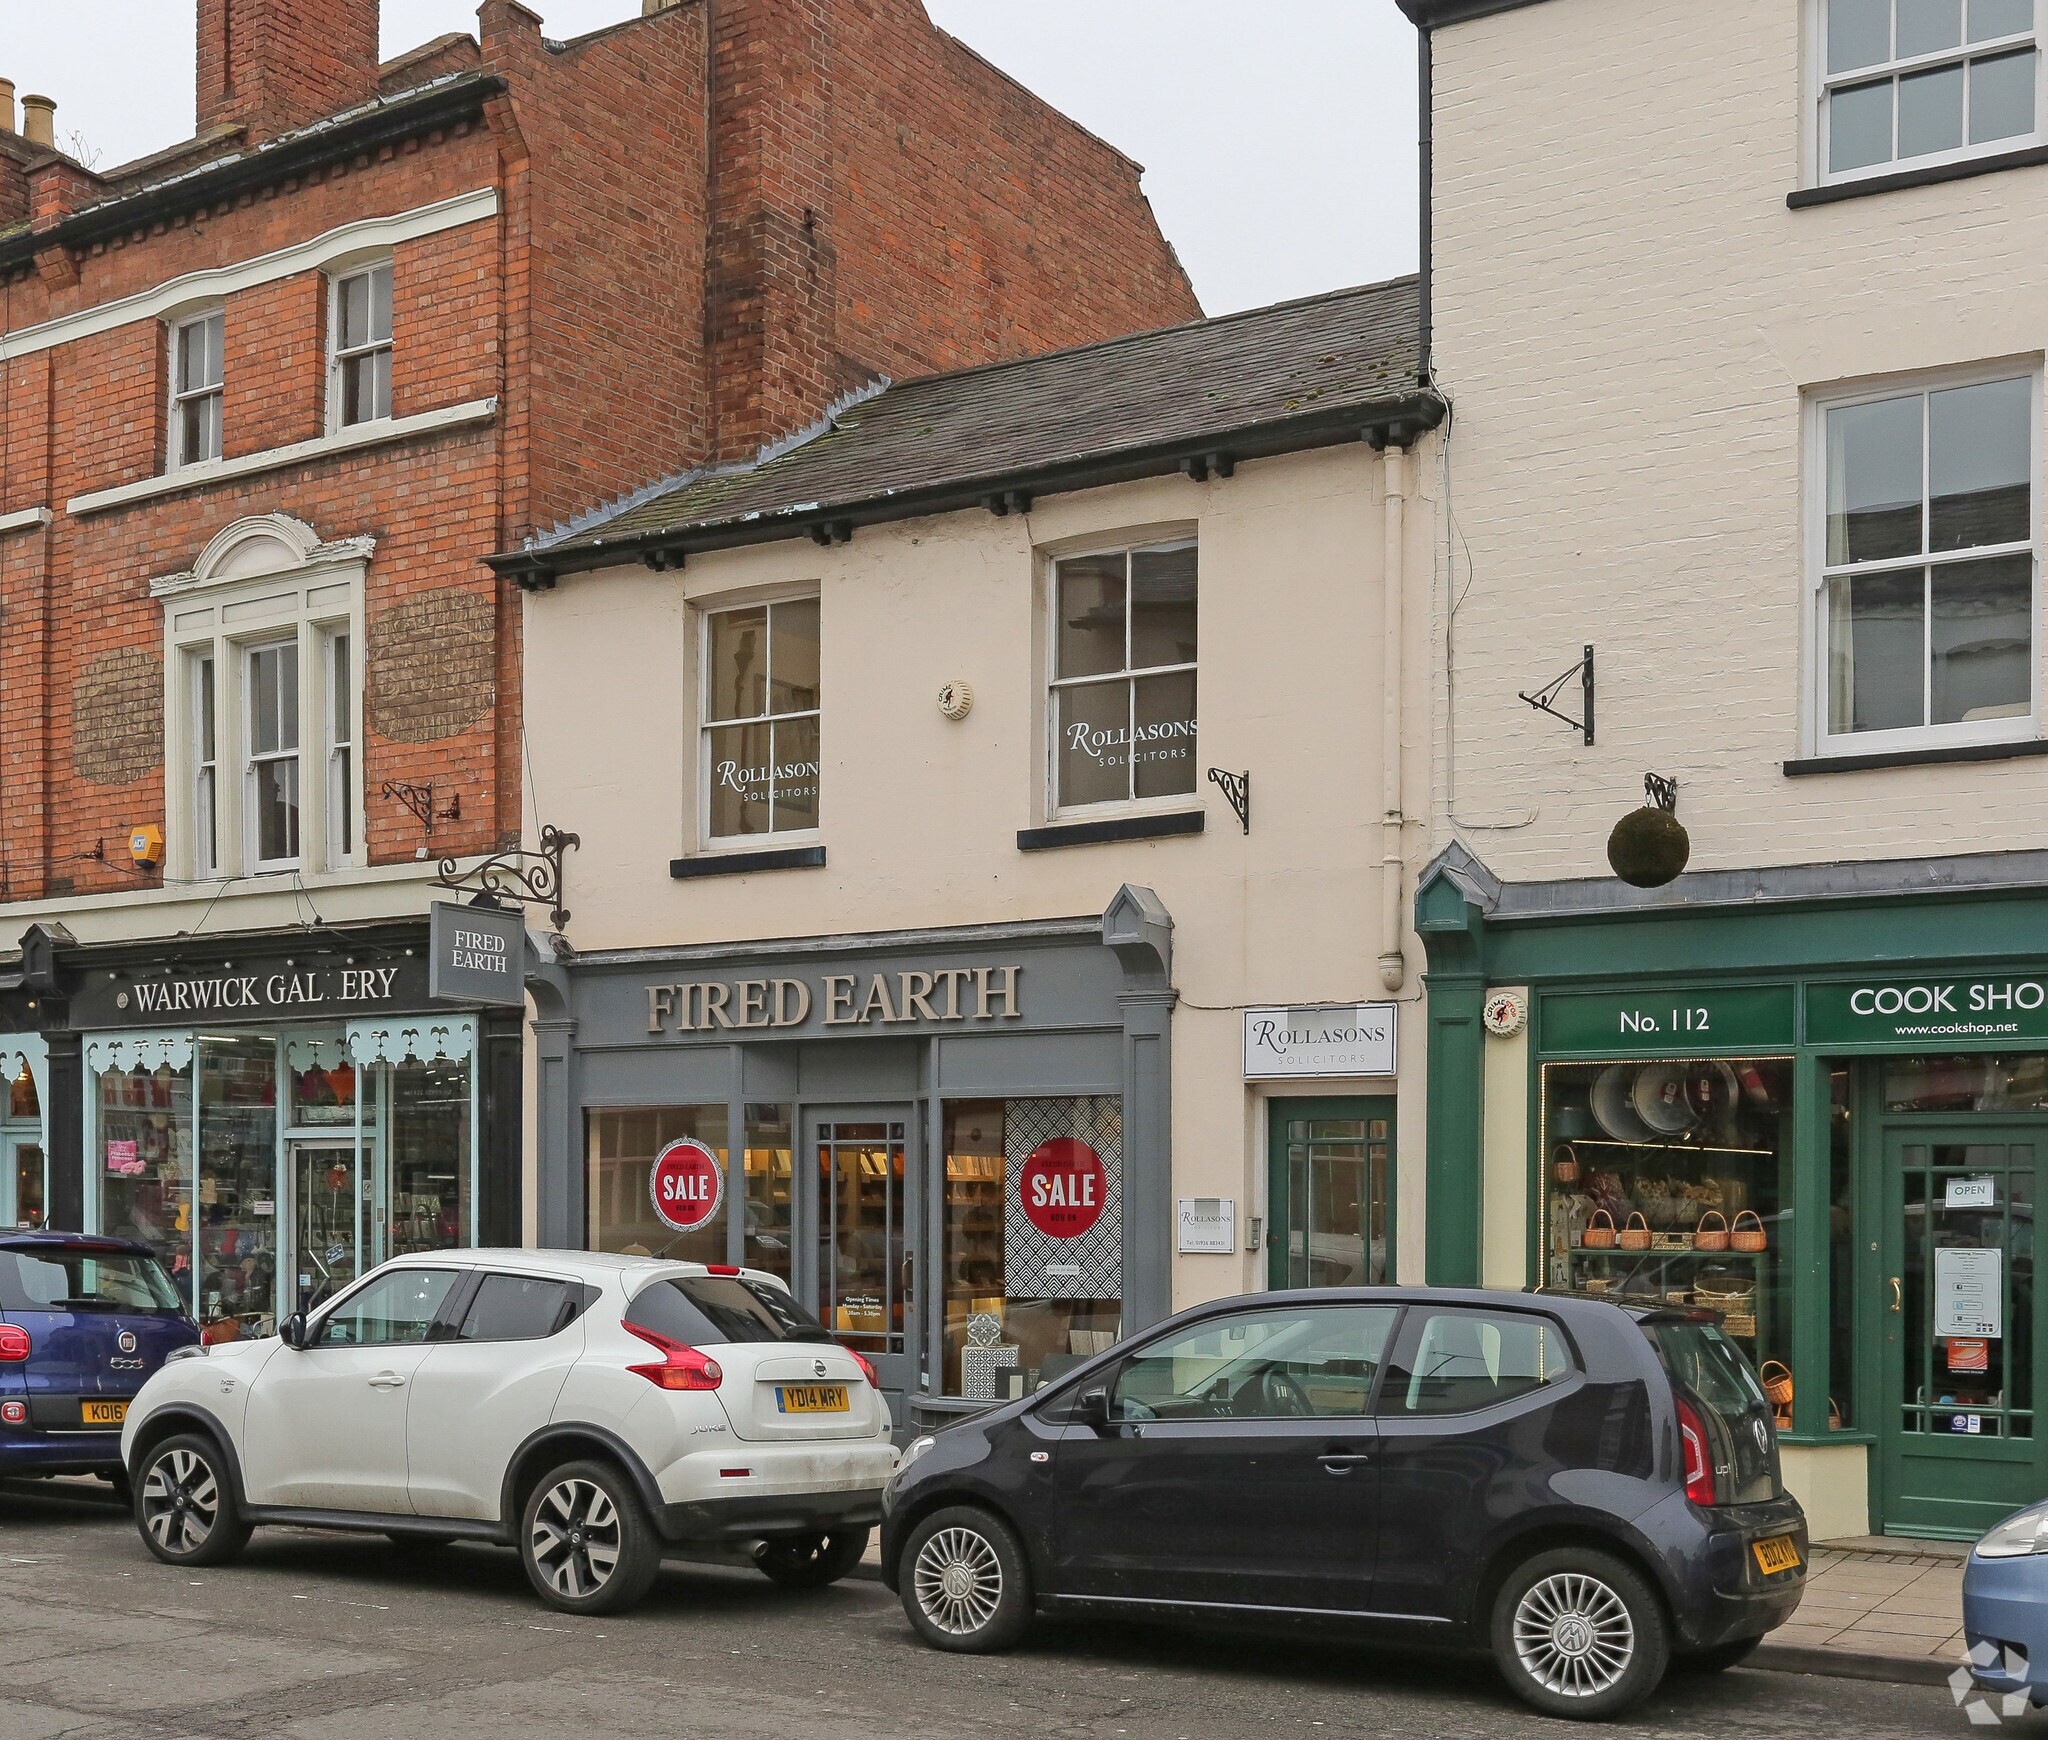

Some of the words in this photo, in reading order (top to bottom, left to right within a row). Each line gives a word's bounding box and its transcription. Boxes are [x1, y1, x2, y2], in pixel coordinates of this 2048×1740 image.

[1099, 748, 1186, 767] SOLICITORS
[717, 760, 820, 792] ROLLASON
[743, 786, 817, 801] SOLICITORS
[454, 930, 505, 952] FIRED
[452, 949, 507, 973] EARTH
[134, 977, 260, 1012] WARWICK
[644, 978, 811, 1032] FIRED
[821, 965, 1021, 1025] EARTH
[1850, 985, 1957, 1015] COOK
[1969, 982, 2047, 1011] SHO
[1620, 1010, 1660, 1033] No.
[1672, 1008, 1710, 1031] 112
[1895, 1022, 2018, 1035] www.cookshop.net
[1253, 1020, 1385, 1054] ROLLASONS
[1278, 1054, 1366, 1065] SOLICITORS
[663, 1175, 709, 1200] SALE
[1031, 1173, 1095, 1207] SALE
[1955, 1186, 1986, 1195] OPEN
[1181, 1211, 1231, 1226] ROLLASONS
[786, 1388, 817, 1407] YD14
[819, 1388, 843, 1407] MRY
[690, 1424, 727, 1435] JUKE
[1715, 1462, 1732, 1476] up!
